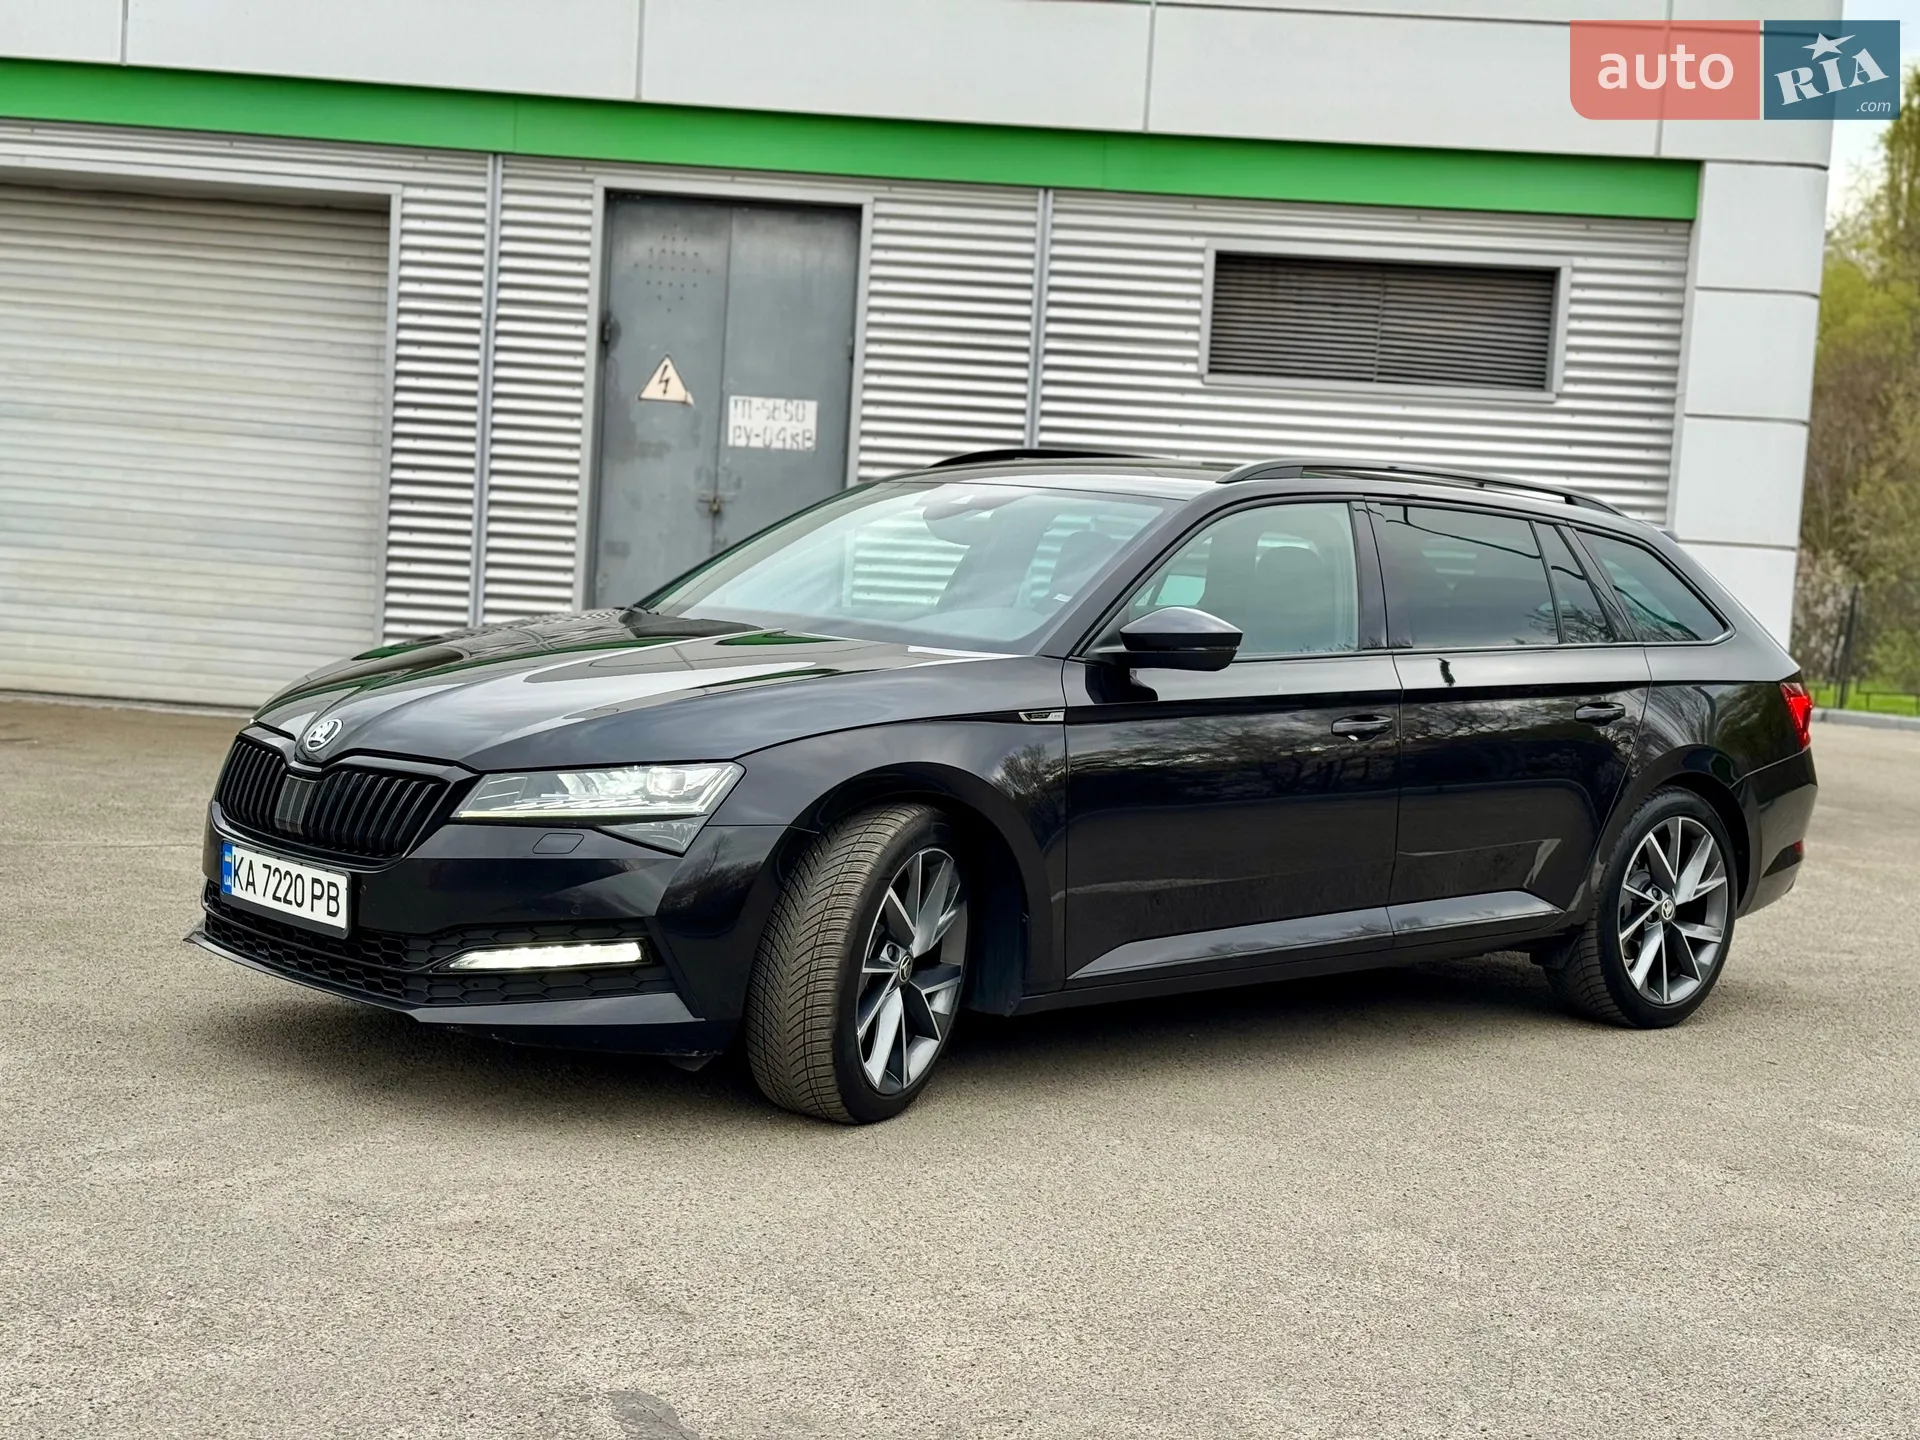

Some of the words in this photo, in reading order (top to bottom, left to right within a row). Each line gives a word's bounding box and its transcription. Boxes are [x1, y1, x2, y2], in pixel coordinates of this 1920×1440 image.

[223, 874, 232, 887] UA
[233, 853, 257, 895] KA
[262, 863, 305, 908] 7220
[310, 877, 341, 918] PB
